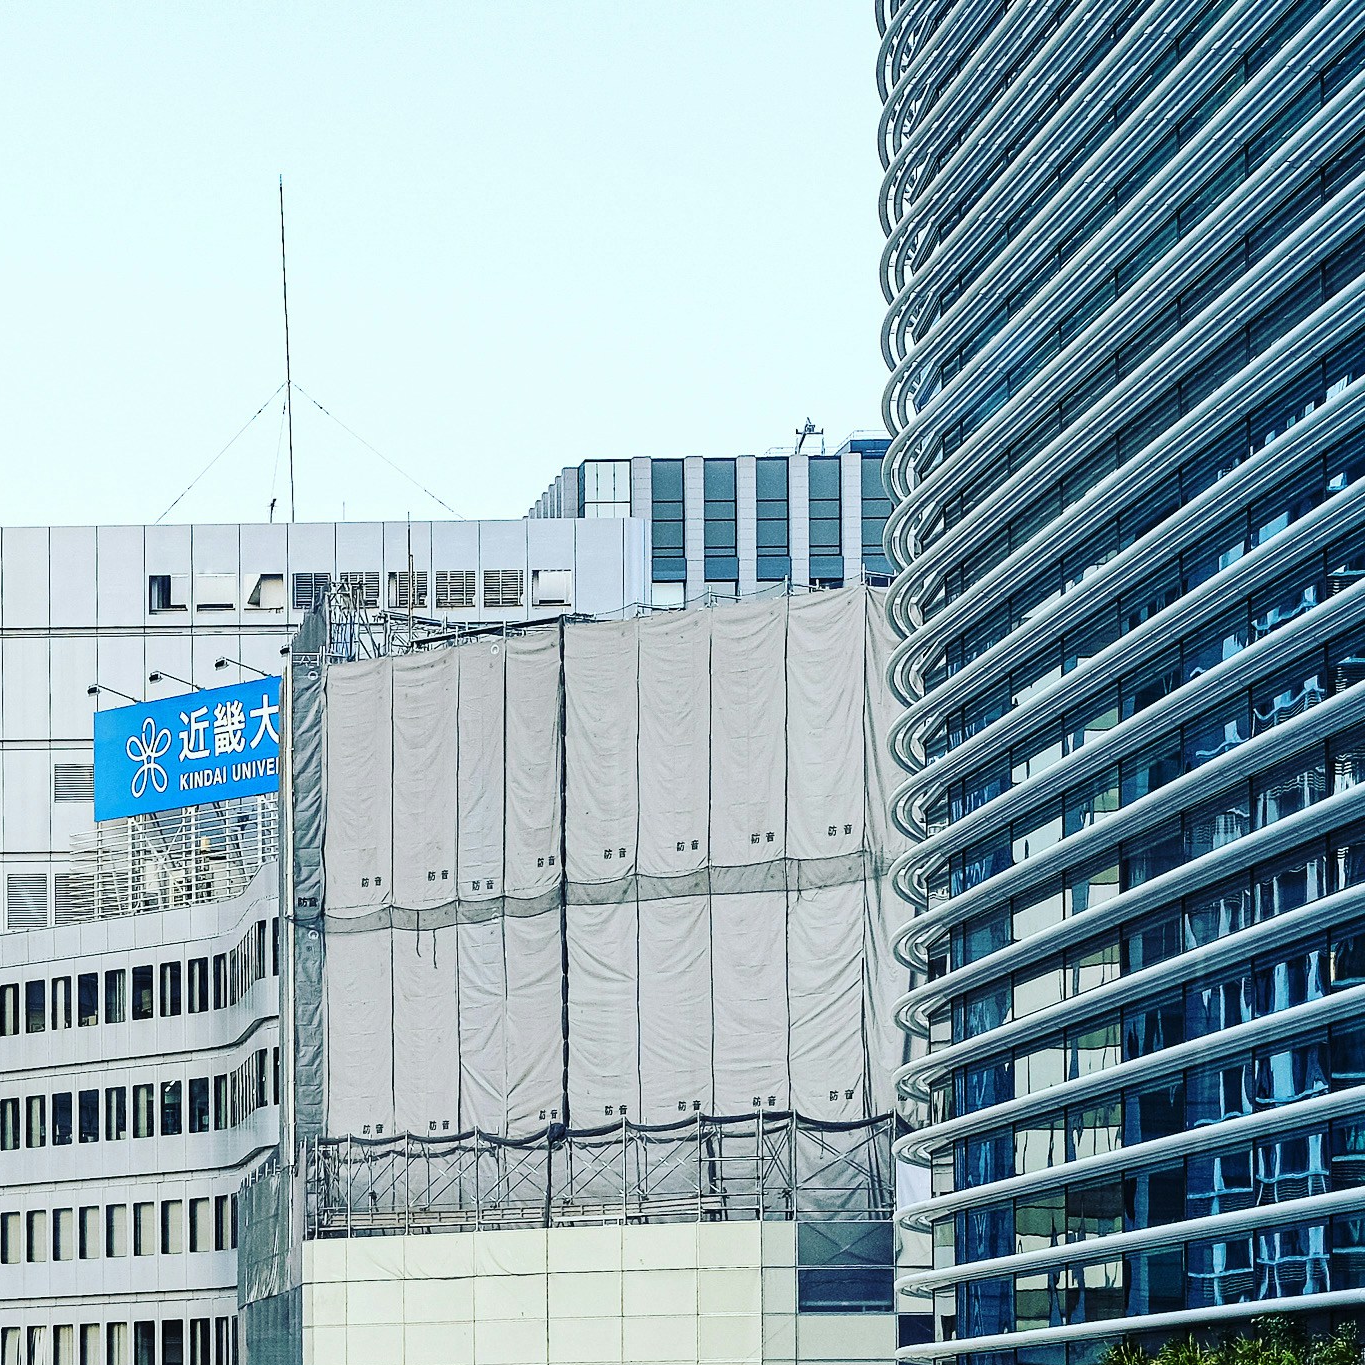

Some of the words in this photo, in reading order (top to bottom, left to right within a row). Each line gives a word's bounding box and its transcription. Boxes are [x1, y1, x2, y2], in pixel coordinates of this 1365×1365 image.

[178, 694, 279, 763] 近畿大
[179, 765, 227, 791] KINDAI
[232, 757, 279, 782] UNIVE
